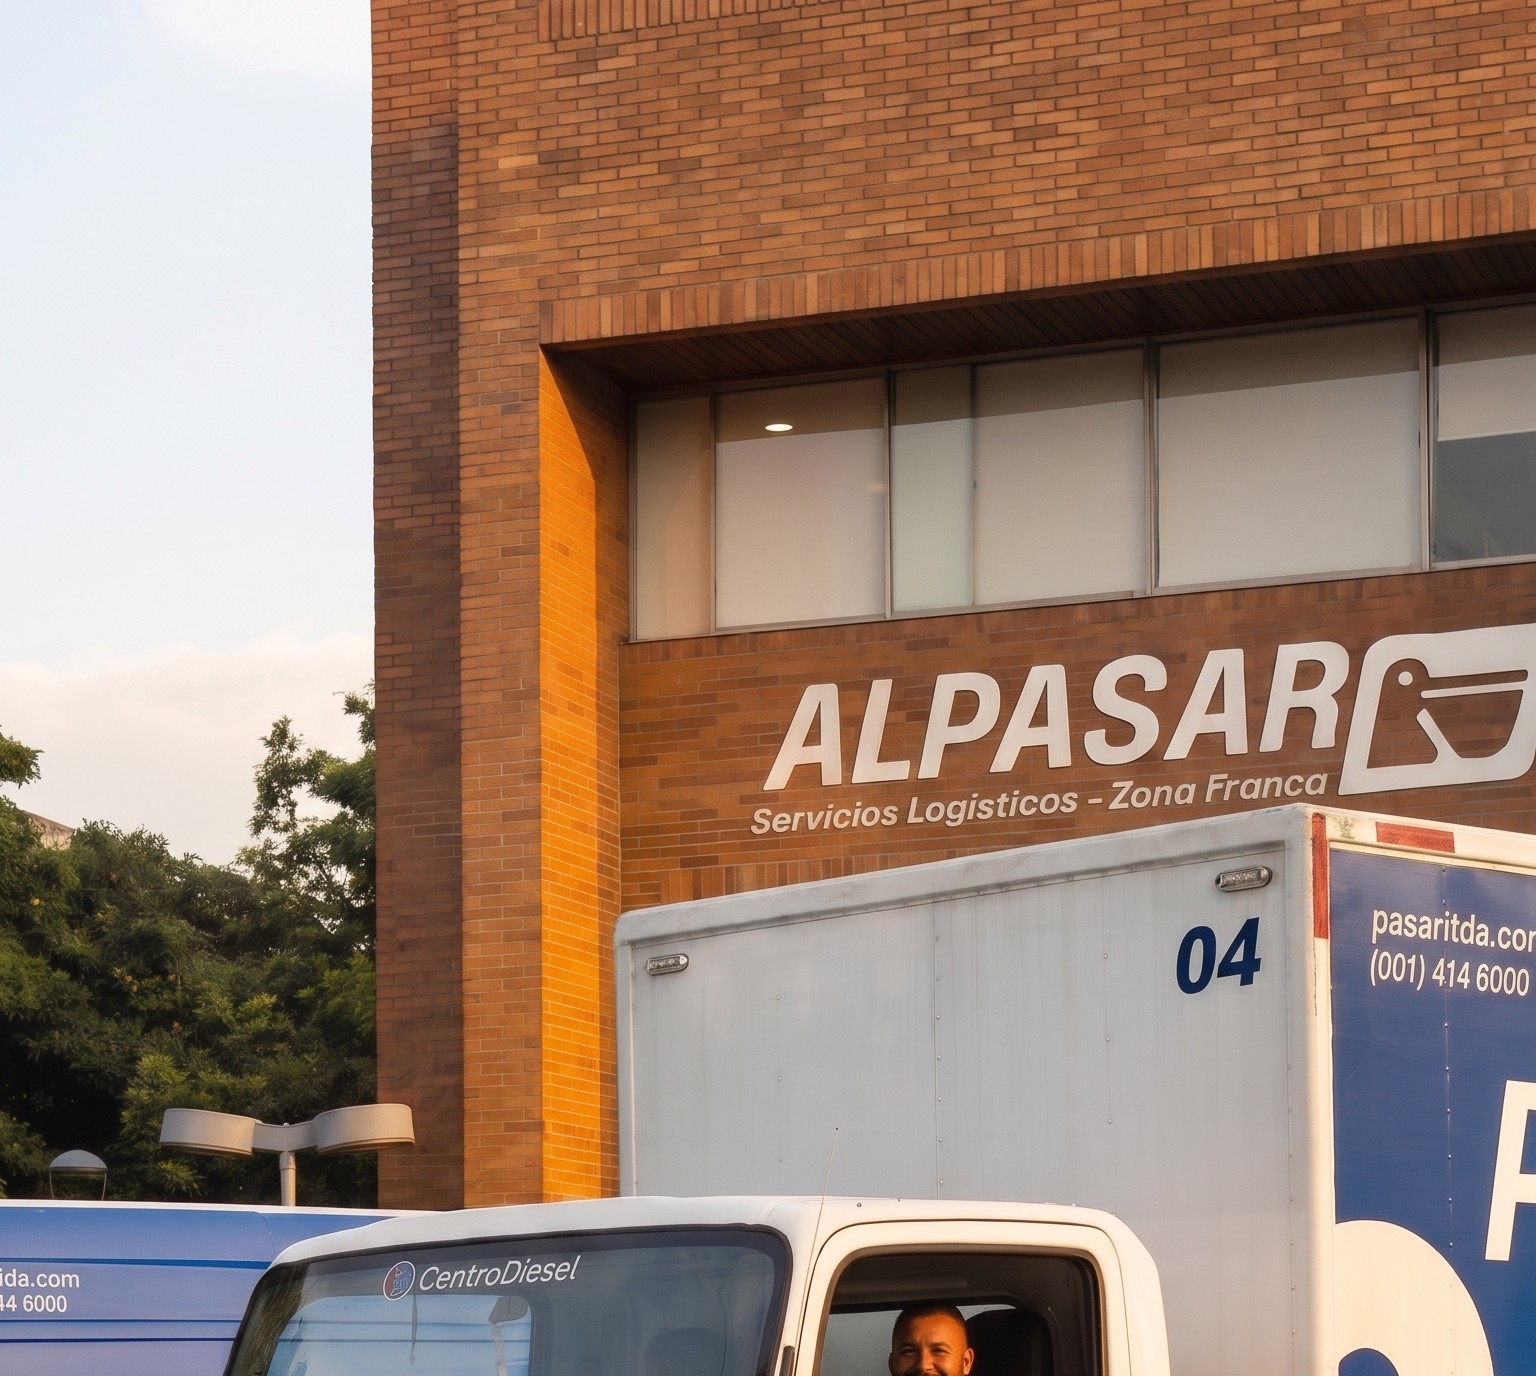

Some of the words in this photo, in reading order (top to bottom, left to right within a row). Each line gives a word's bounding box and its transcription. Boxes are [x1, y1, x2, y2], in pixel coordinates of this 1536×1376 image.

[763, 641, 1349, 790] ALPASAR
[750, 801, 898, 834] Servicios
[907, 790, 1078, 827] Logisticos
[1109, 780, 1196, 809] Zona
[1205, 773, 1328, 802] Franca
[1176, 917, 1261, 994] 04
[1370, 948, 1425, 991] (001)
[1432, 957, 1470, 989] 414
[1476, 963, 1529, 996] 6000
[419, 1255, 581, 1291] CentroDiesel
[23, 1295, 67, 1312] 6000
